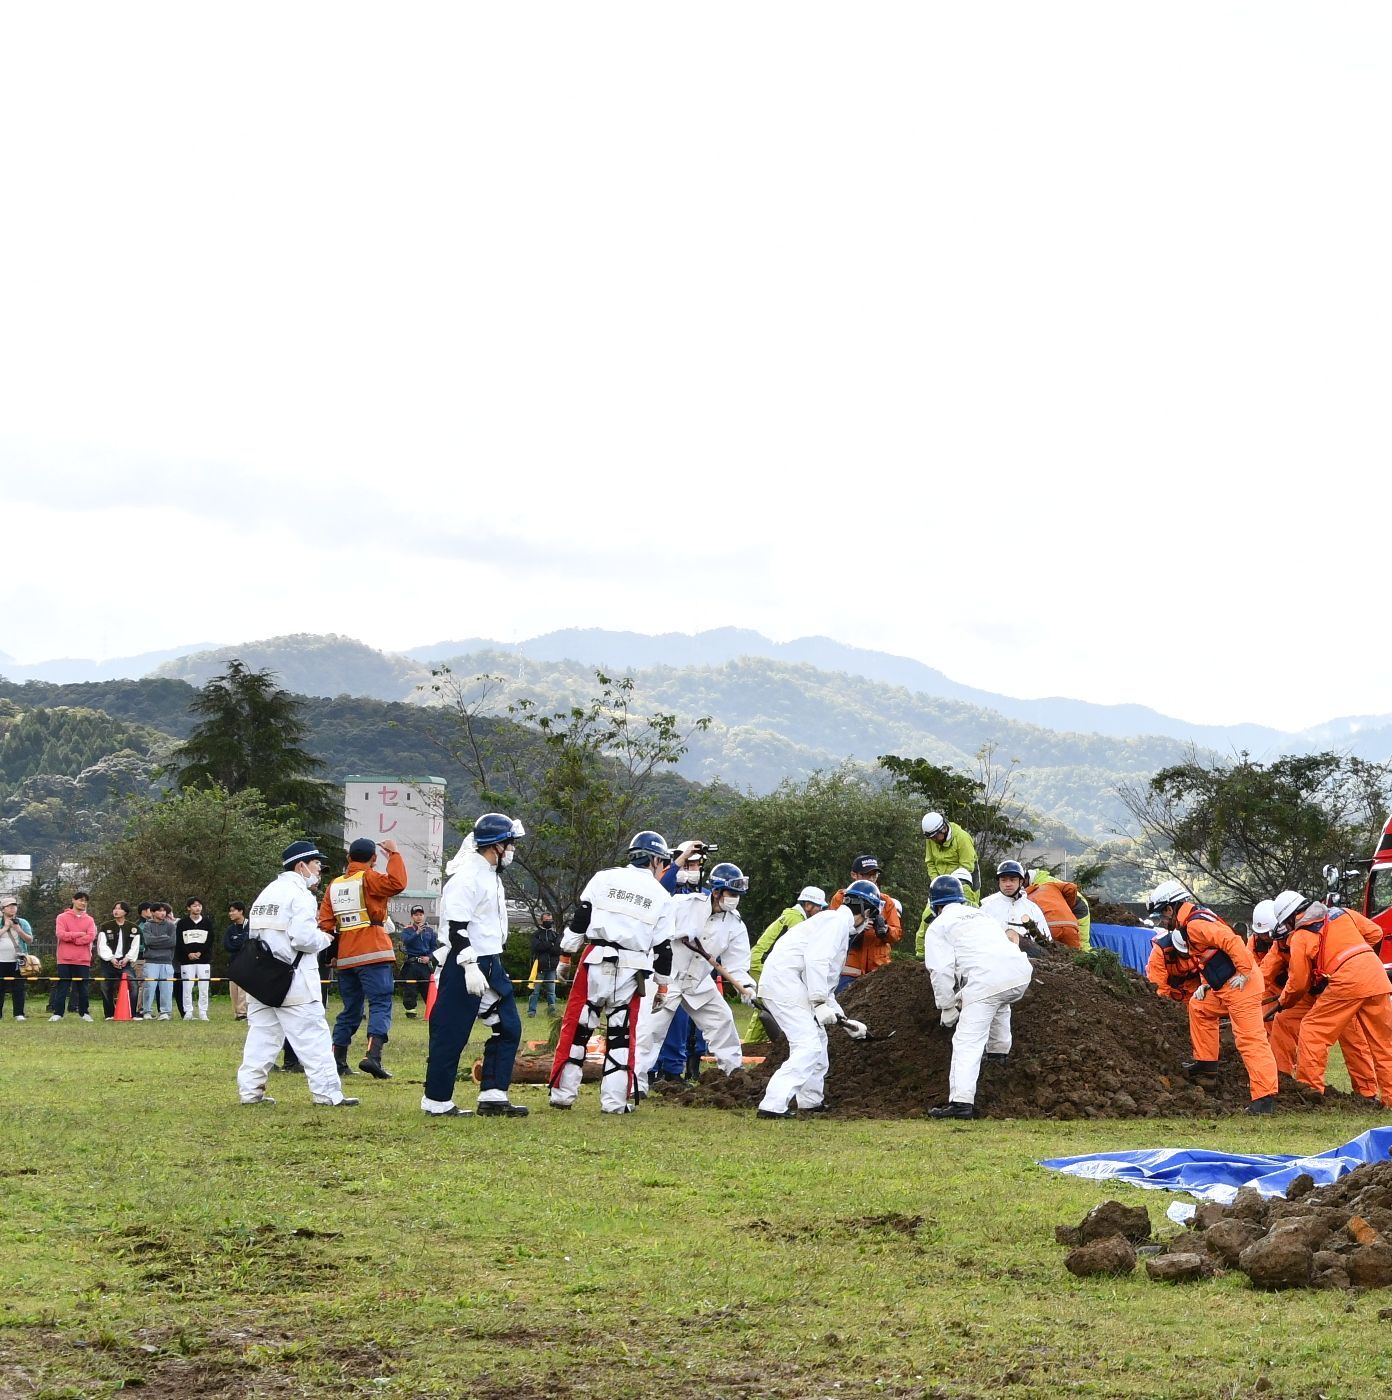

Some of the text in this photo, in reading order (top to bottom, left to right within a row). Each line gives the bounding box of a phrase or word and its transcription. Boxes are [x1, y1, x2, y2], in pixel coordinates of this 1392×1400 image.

[377, 785, 398, 858] セレ
[607, 888, 653, 909] 京都府警察
[252, 904, 280, 916] 京都警察
